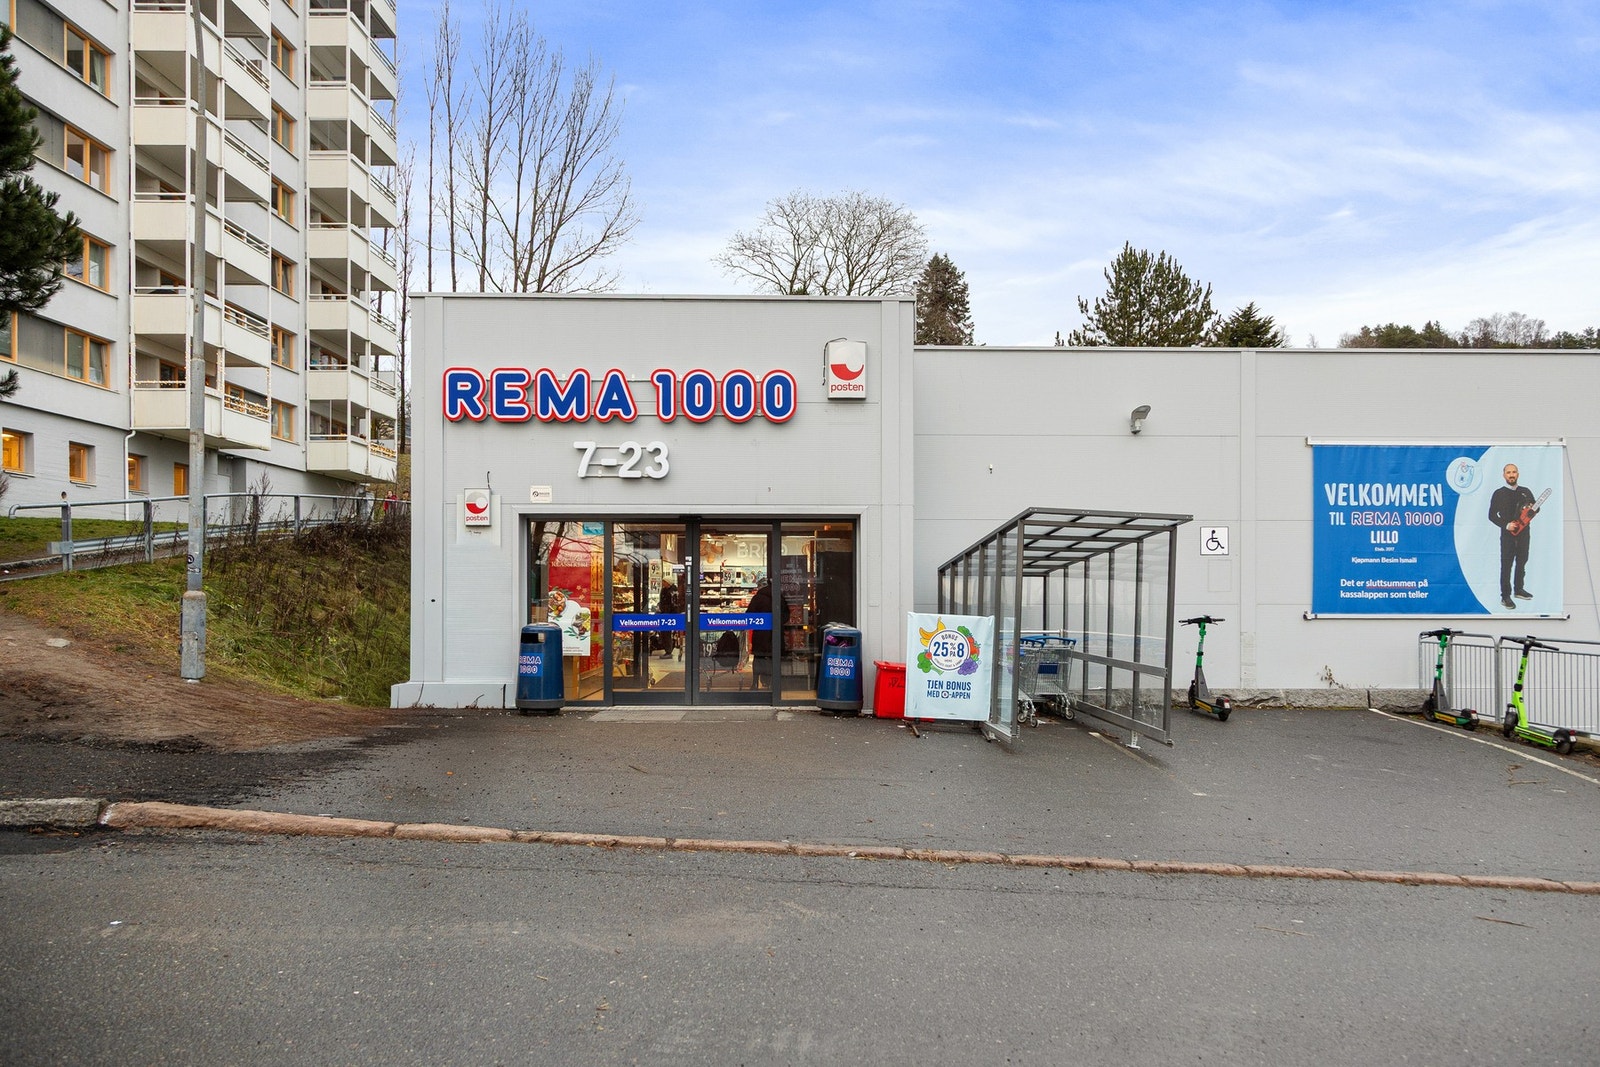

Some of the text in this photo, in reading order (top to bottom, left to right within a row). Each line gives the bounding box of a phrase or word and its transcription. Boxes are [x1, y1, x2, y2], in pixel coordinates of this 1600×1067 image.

[830, 383, 864, 393] posten
[443, 367, 798, 423] REMA 1000
[573, 441, 670, 479] 7-23
[1324, 482, 1444, 507] VELKOMMEN
[1329, 511, 1444, 526] TIL REMA 1000
[1370, 530, 1399, 544] LILLO
[1351, 556, 1380, 564] Kjøpmann
[1340, 578, 1354, 587] Det
[1366, 579, 1416, 588] sluttsummen
[1418, 578, 1428, 588] på
[1340, 590, 1388, 599] kassalappen
[1408, 590, 1429, 598] teller
[941, 633, 958, 641] BONUS
[933, 641, 949, 657] 25
[957, 642, 965, 658] 8
[827, 657, 854, 667] REMA
[829, 667, 851, 676] 1000
[926, 679, 972, 691] TJEN BONUS
[926, 690, 940, 698] MED
